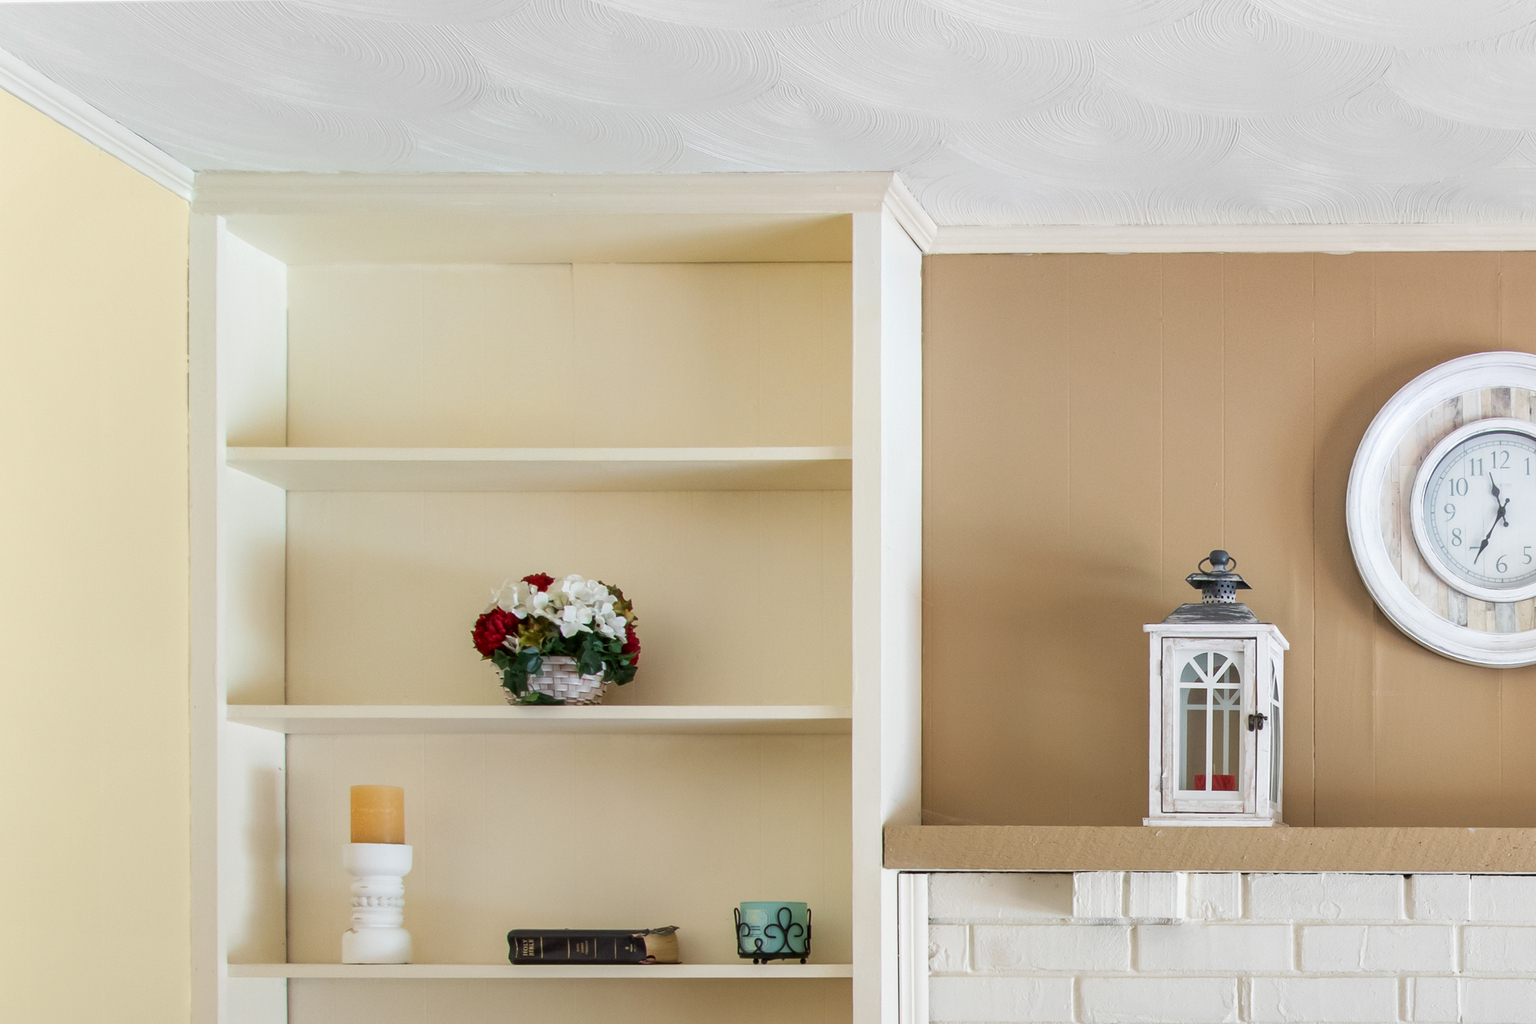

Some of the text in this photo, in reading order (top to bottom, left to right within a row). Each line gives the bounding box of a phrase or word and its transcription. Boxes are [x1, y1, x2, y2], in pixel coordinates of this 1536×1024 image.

[1469, 457, 1484, 477] 11
[1490, 450, 1510, 469] 12
[1524, 457, 1531, 476] 1
[1448, 477, 1469, 497] 10
[1443, 503, 1456, 522] 9
[1451, 527, 1463, 547] 8
[1495, 554, 1508, 574] 6
[1522, 546, 1532, 565] 5
